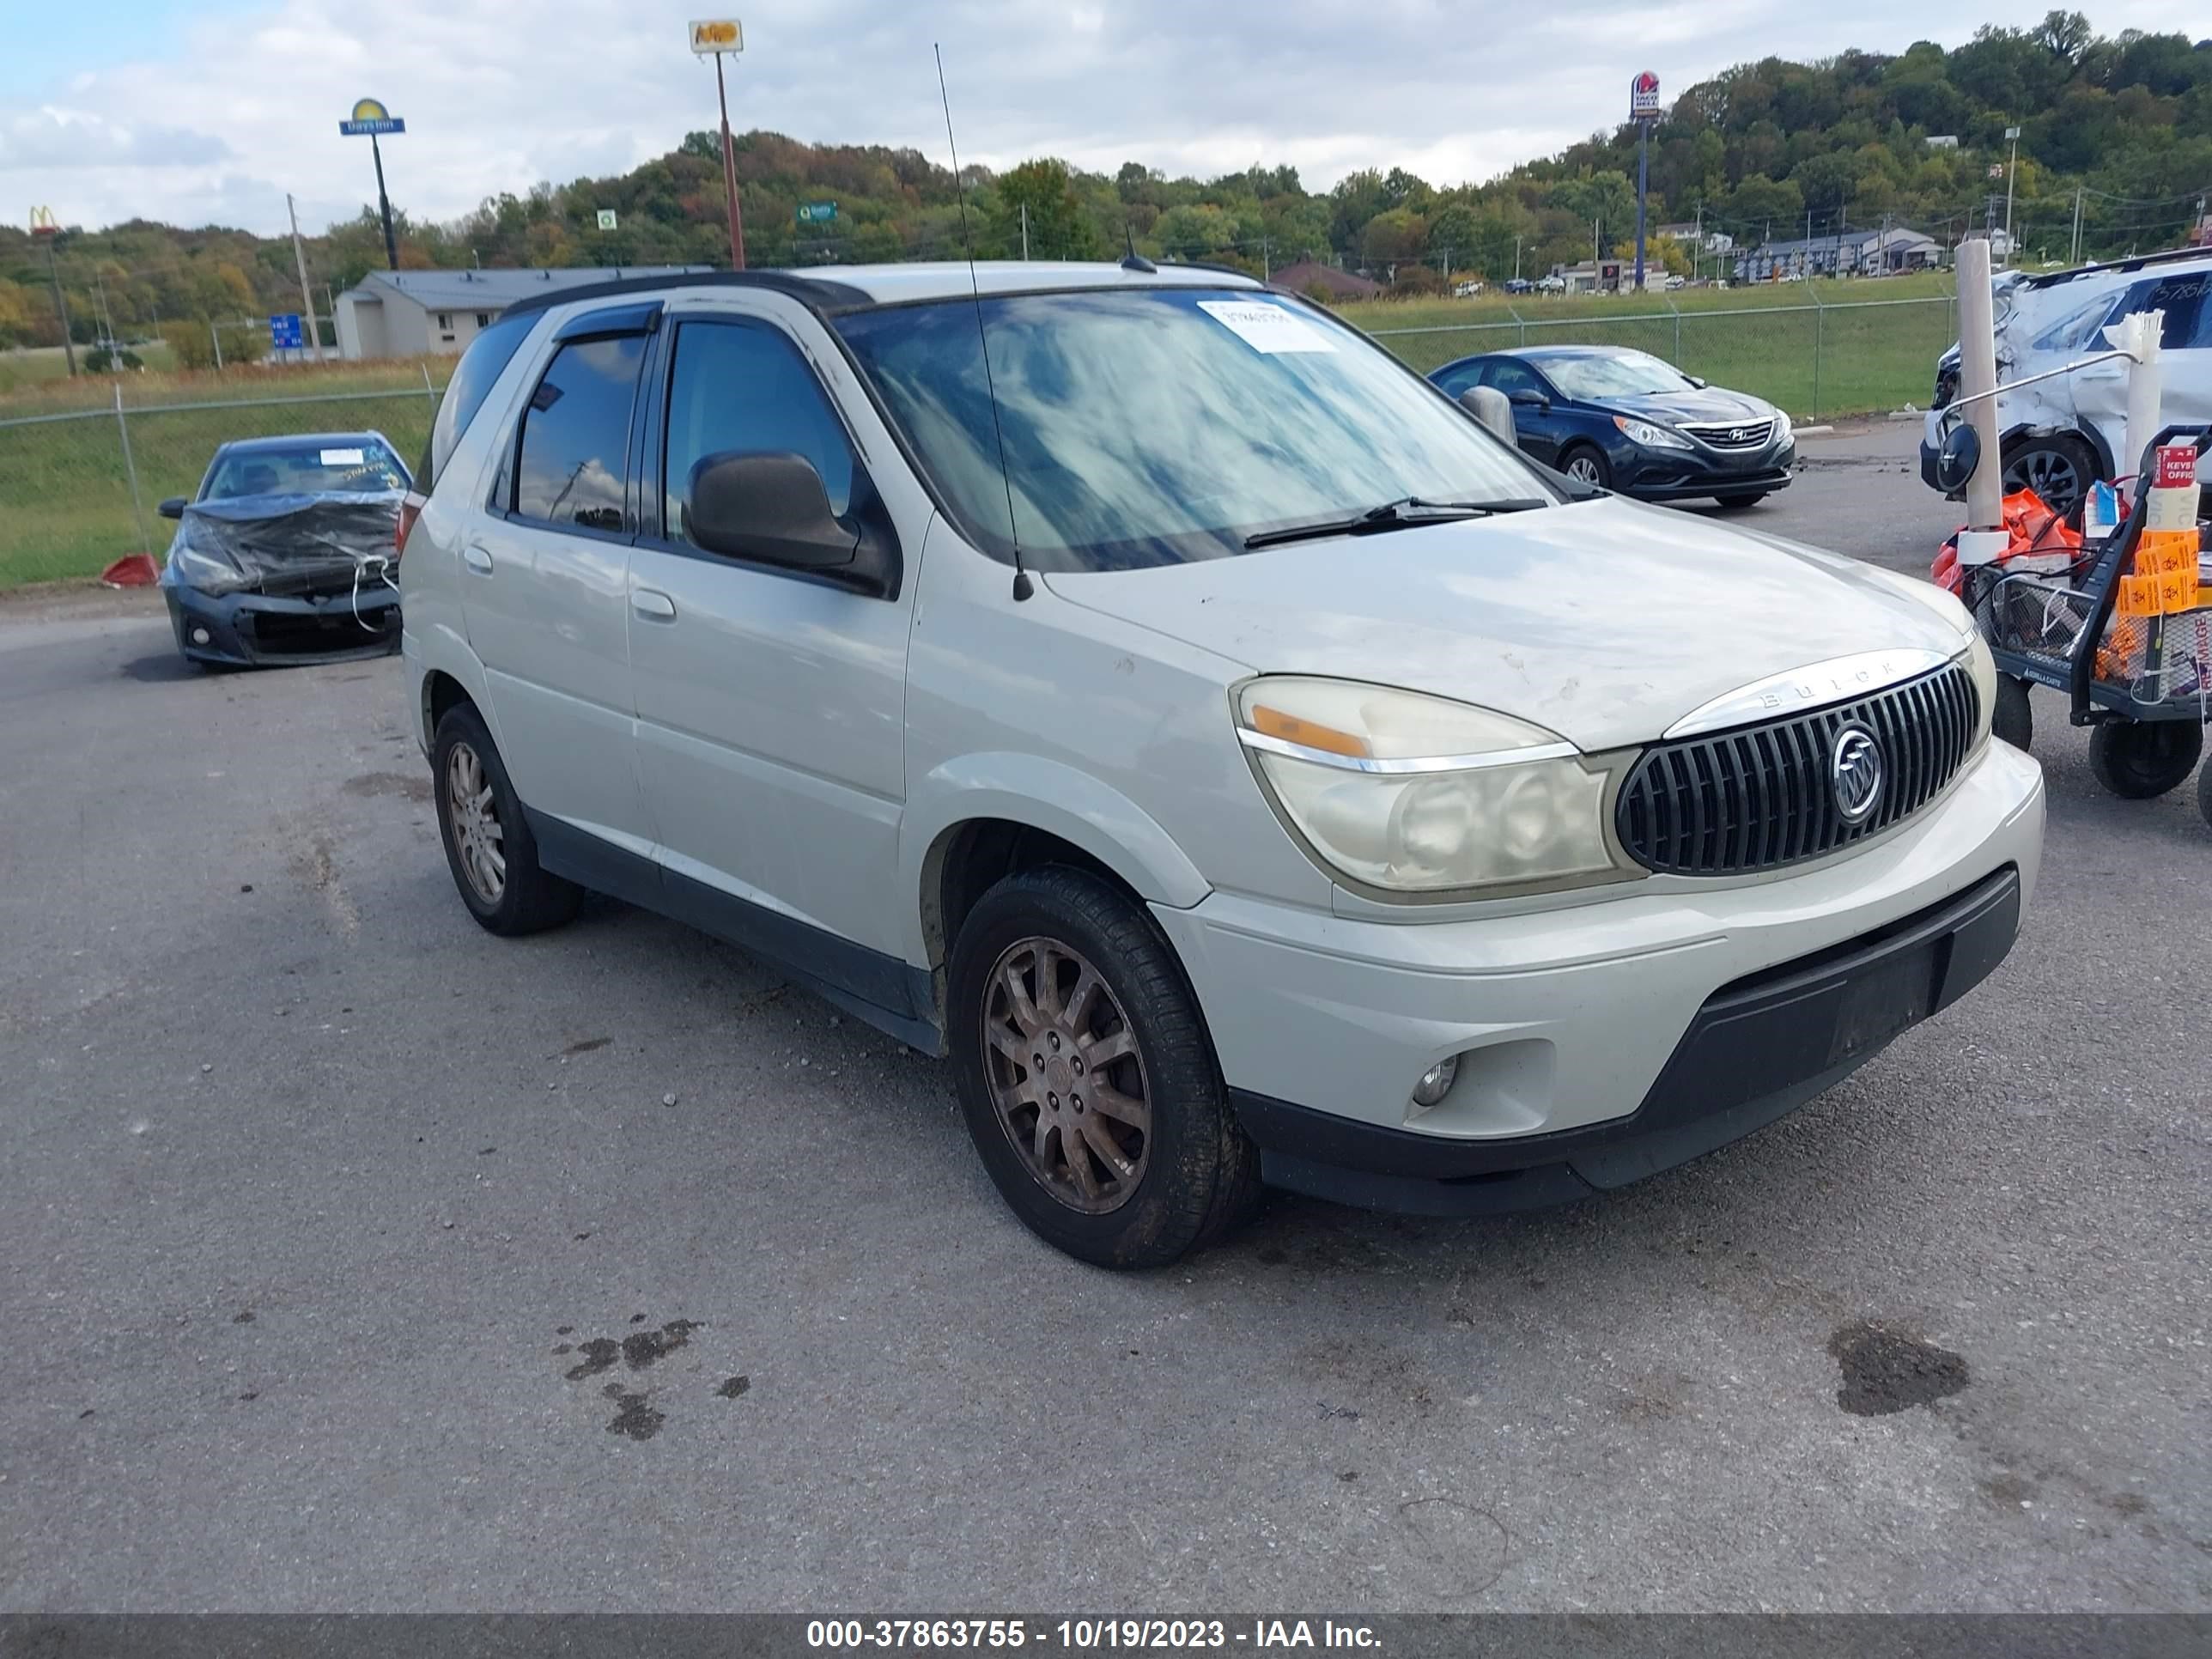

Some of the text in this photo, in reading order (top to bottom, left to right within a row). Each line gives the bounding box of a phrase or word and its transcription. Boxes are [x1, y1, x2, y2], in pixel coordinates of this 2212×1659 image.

[2166, 461, 2191, 470] KEYS
[2167, 471, 2194, 479] OFFIC
[1760, 663, 1896, 708] BUICK
